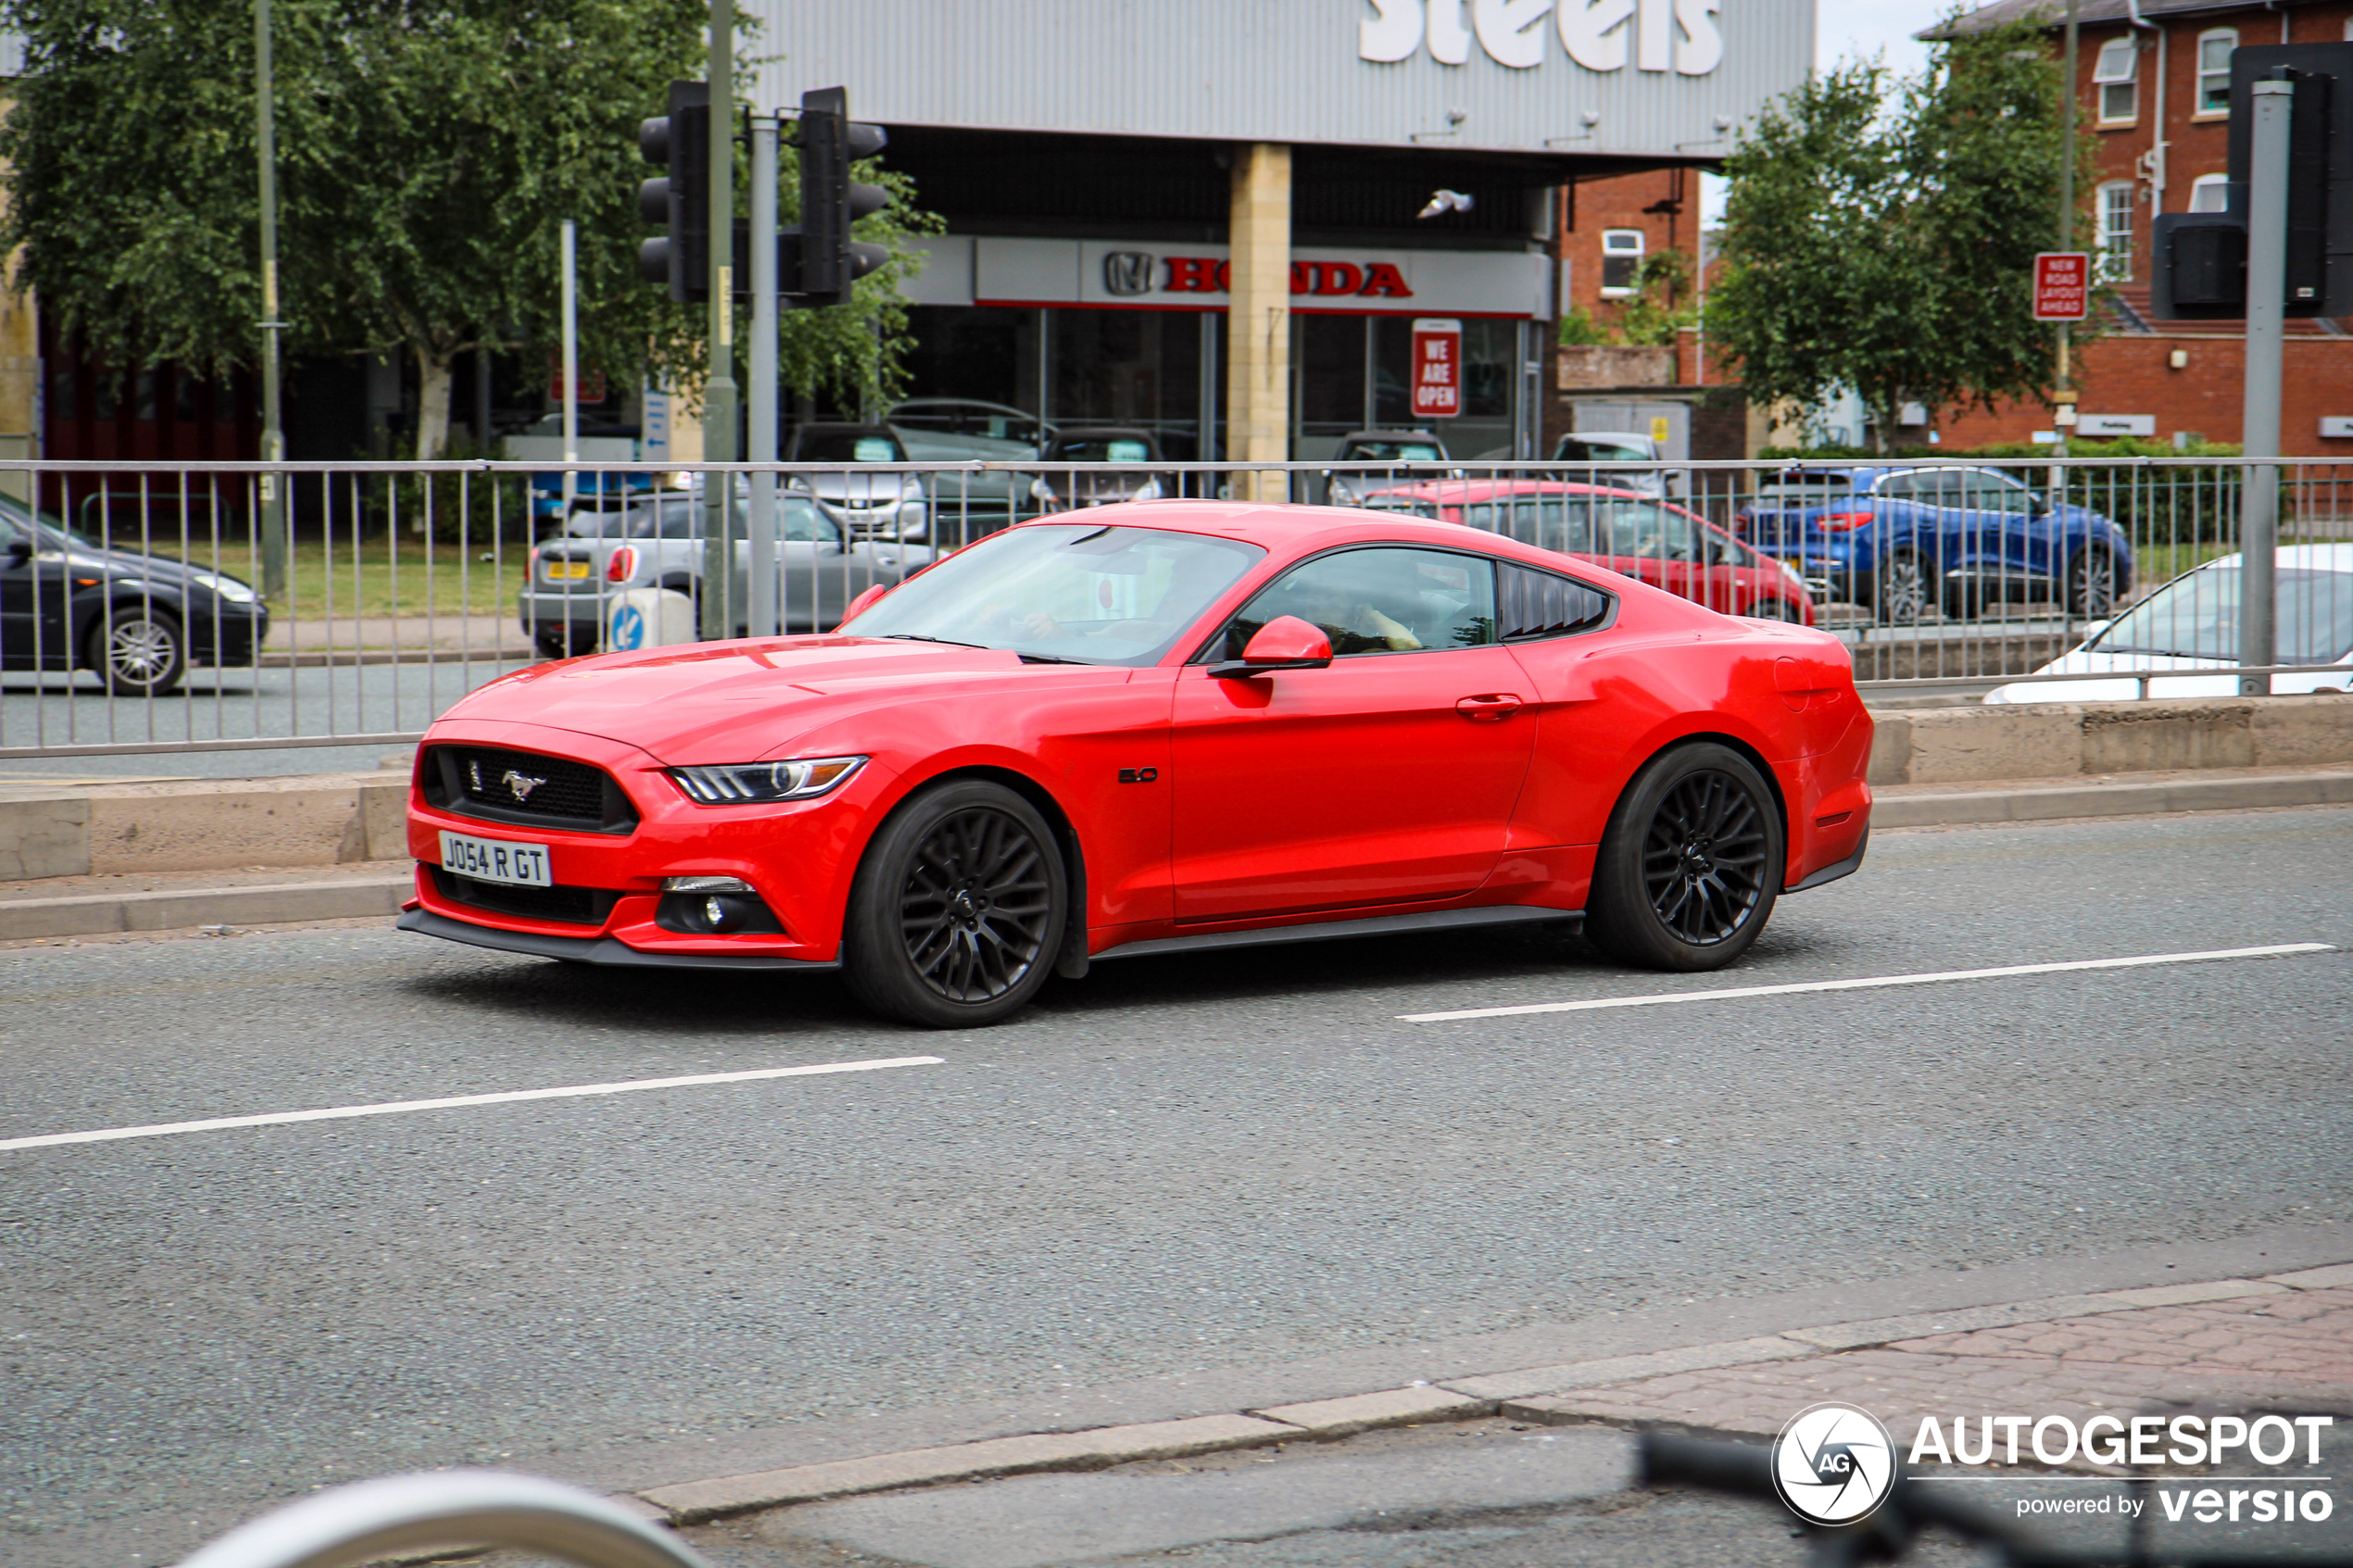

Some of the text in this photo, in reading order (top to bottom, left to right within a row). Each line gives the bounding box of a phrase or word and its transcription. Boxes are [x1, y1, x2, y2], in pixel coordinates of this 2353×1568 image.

[2048, 260, 2076, 271] NEW
[1164, 257, 1415, 296] HDA
[2045, 273, 2078, 285] ROAD
[2040, 286, 2083, 298] LAYOUT
[2041, 301, 2081, 312] AHEAD
[1425, 340, 1450, 360] WE
[1422, 363, 1451, 383] ARE
[1417, 385, 1455, 407] OPEN
[1118, 767, 1158, 784] 5.0
